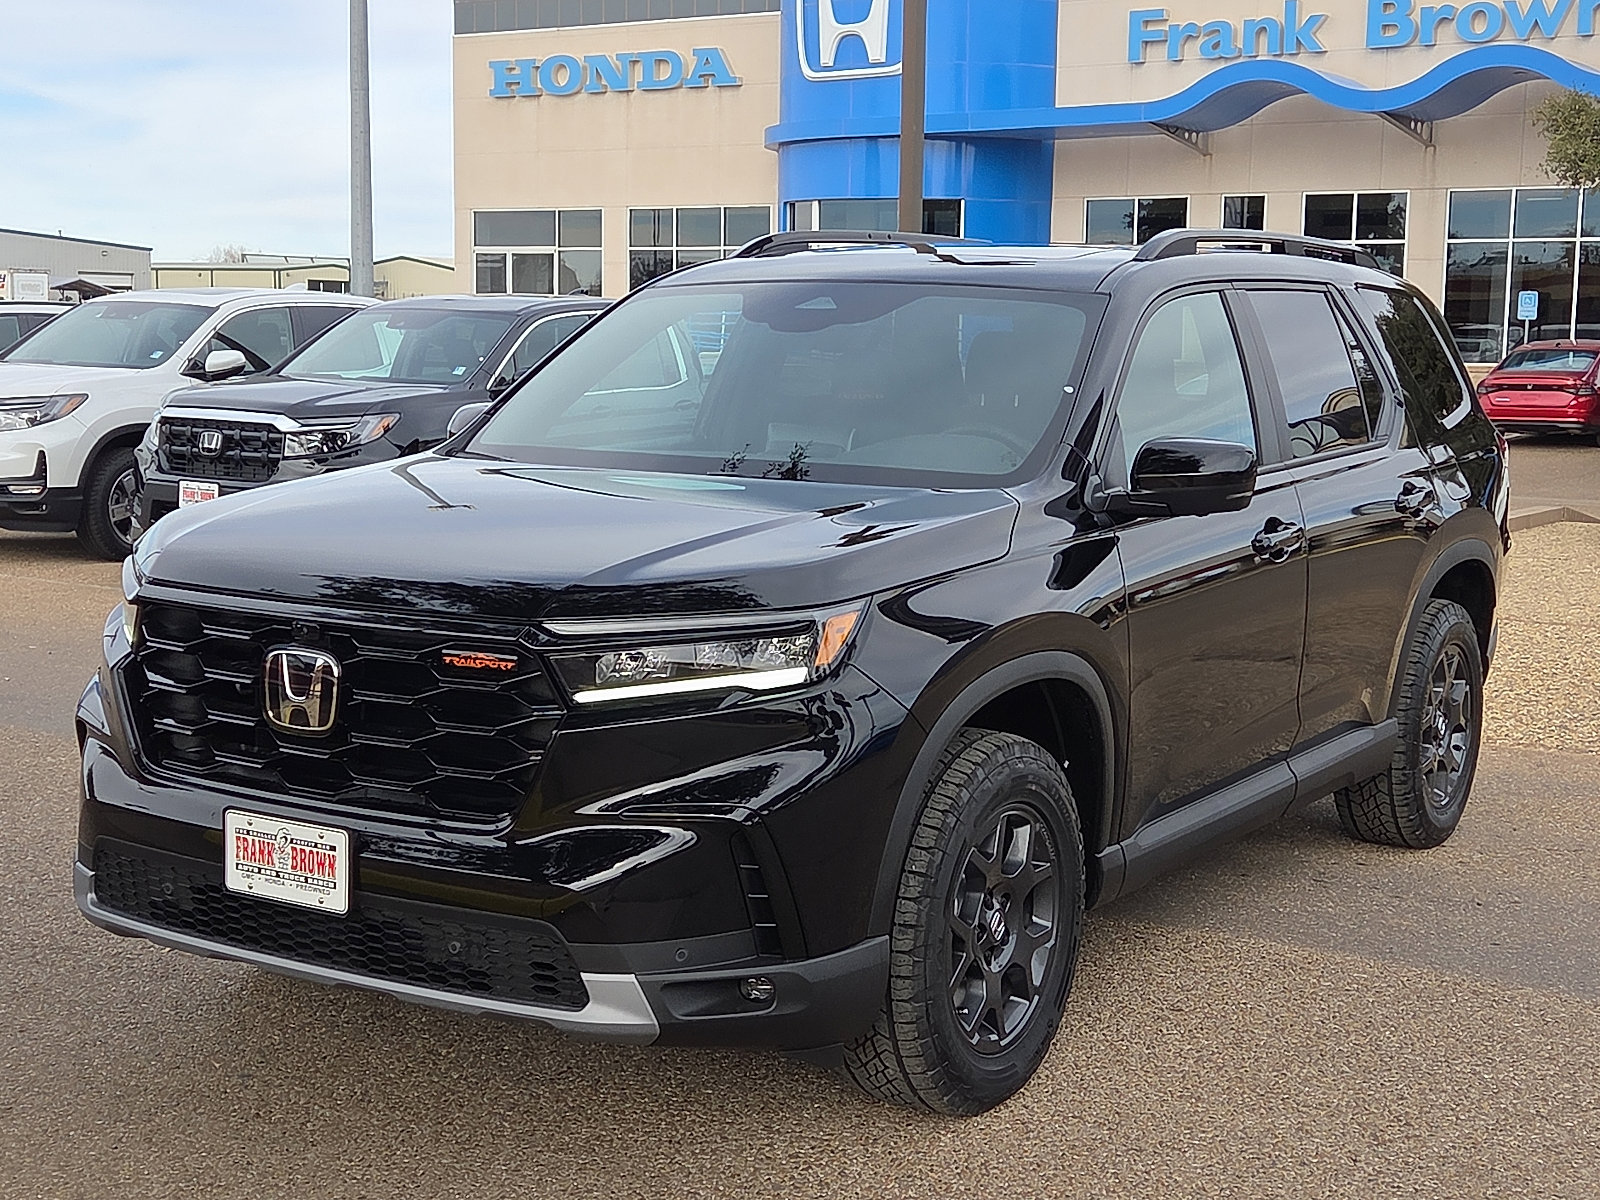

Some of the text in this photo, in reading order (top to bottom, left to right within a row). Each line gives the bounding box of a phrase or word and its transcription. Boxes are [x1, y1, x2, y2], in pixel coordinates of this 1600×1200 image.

[1127, 0, 1329, 63] Frank
[489, 46, 742, 98] HONDA
[442, 656, 516, 671] TRAILSPORT
[235, 835, 337, 879] FRANK BROWN
[237, 864, 335, 888] AUTO AND TRUCK RANCH
